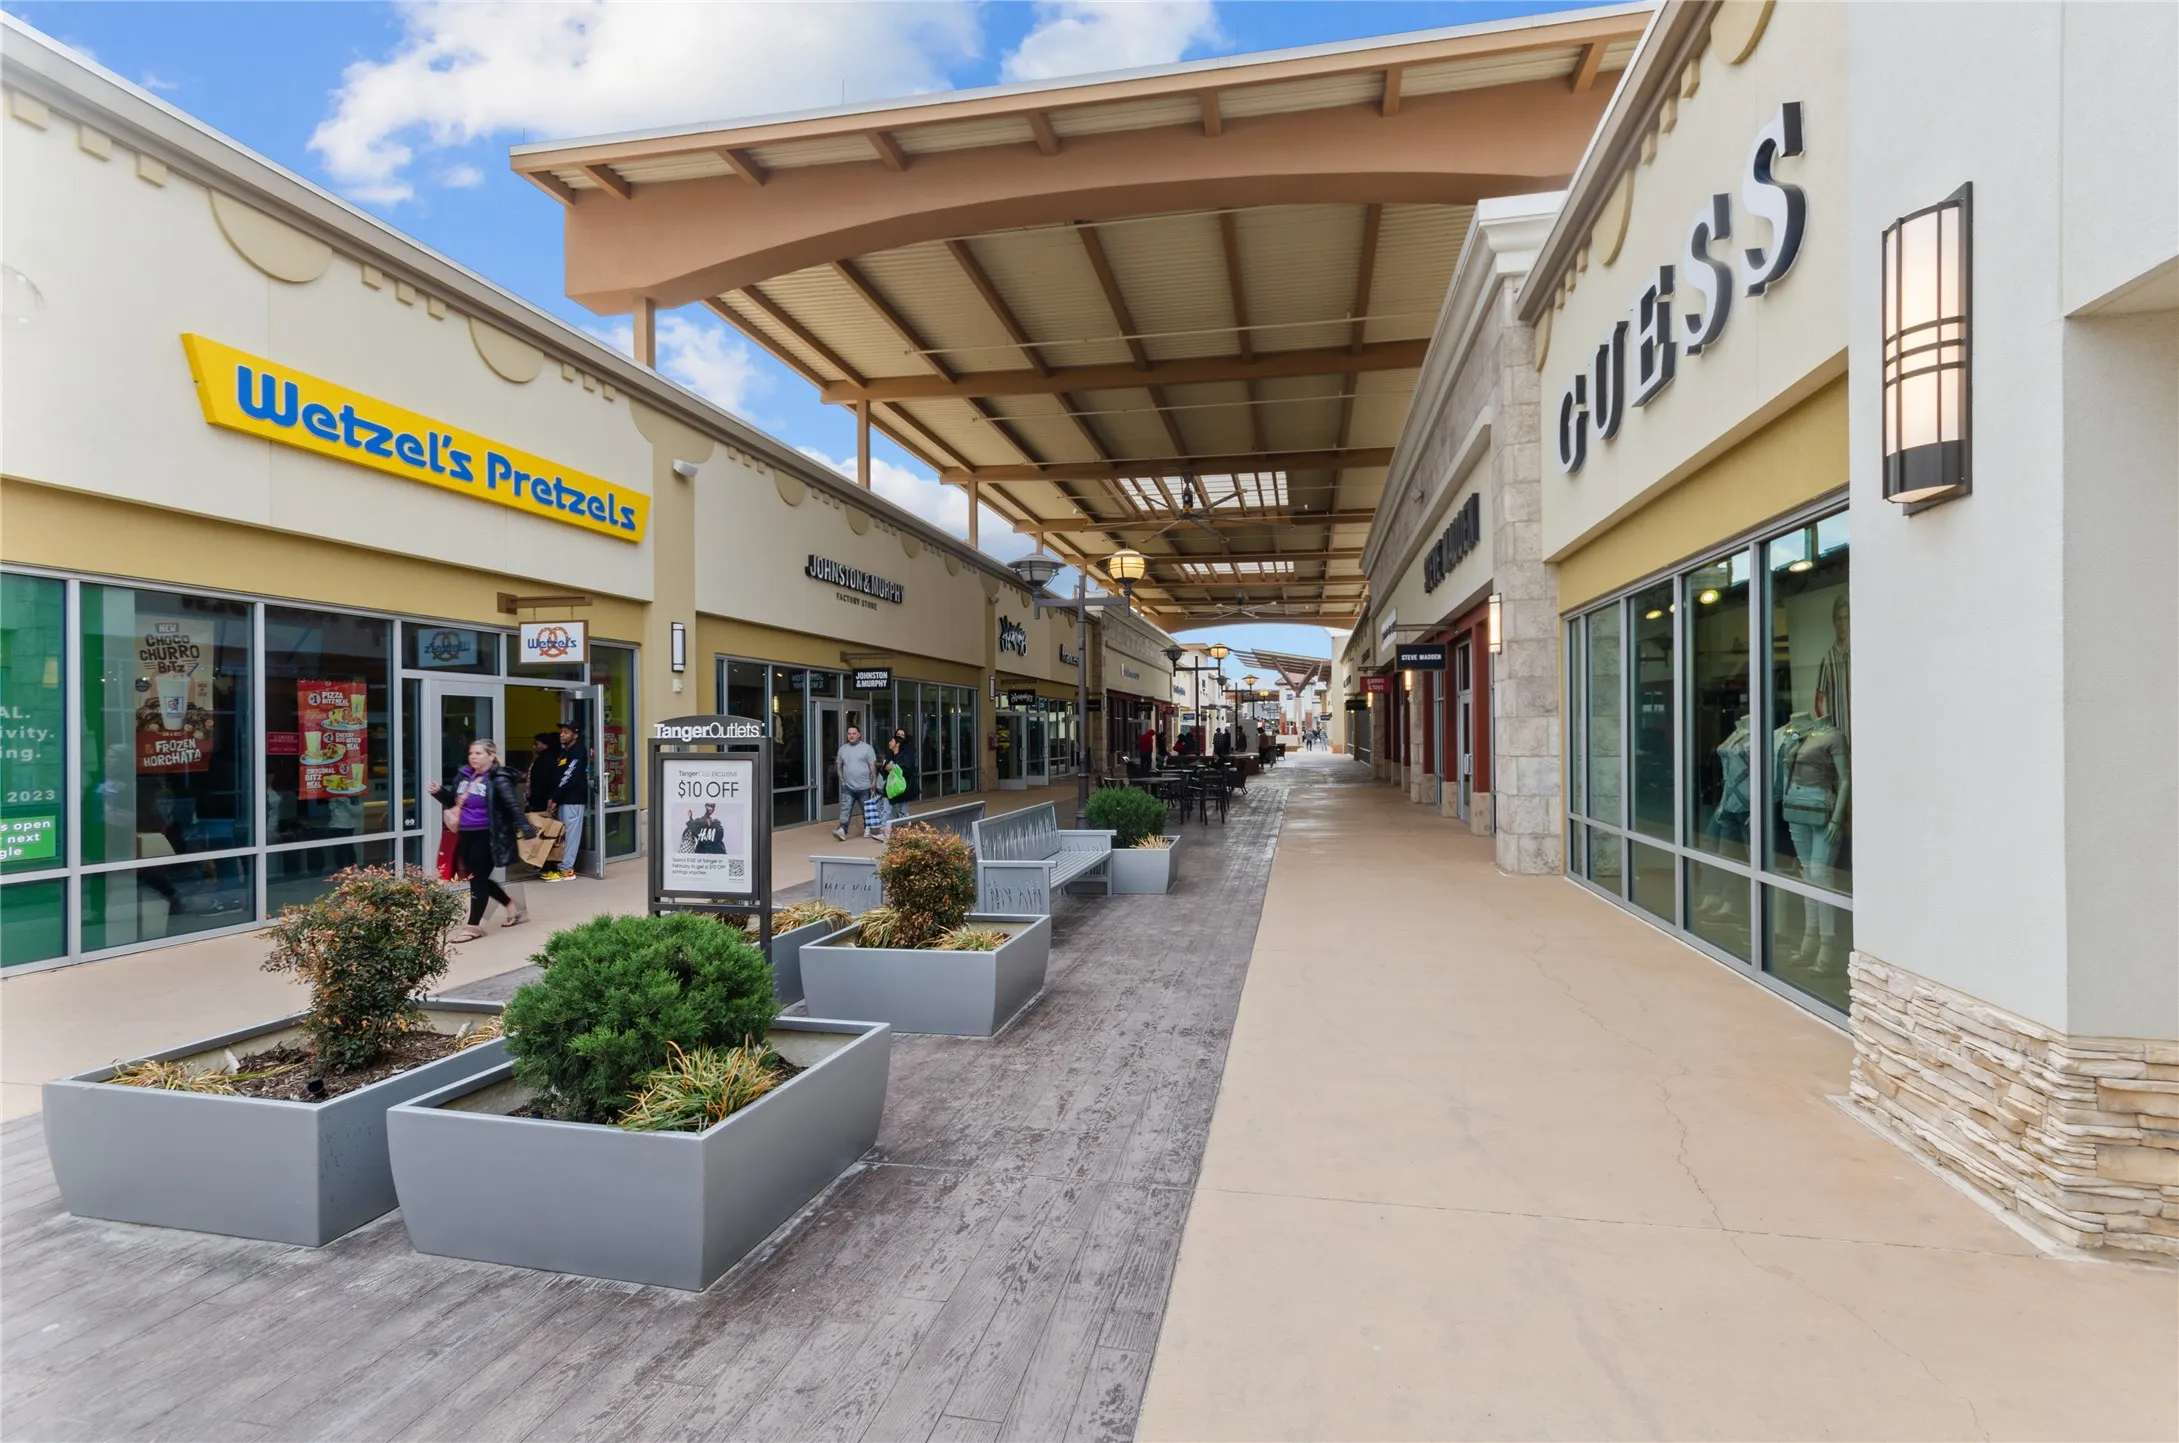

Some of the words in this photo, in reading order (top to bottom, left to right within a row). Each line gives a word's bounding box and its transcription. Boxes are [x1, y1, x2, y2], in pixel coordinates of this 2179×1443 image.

[1559, 101, 1807, 474] GUESS
[237, 364, 473, 482] Wetzel's
[487, 451, 637, 531] Pretzels
[145, 633, 190, 647] CHOCO
[527, 637, 577, 649] Wetzel's
[140, 645, 200, 661] CHURRO
[855, 671, 888, 680] JOHNSTON
[322, 691, 343, 699] PIZZA
[653, 722, 760, 742] TangerOutlets
[155, 738, 196, 753] FROZEN
[143, 749, 201, 767] HORCHATA
[7, 789, 56, 802] 2023
[678, 779, 702, 798] $10
[706, 781, 739, 798] OFF
[13, 819, 51, 833] open
[7, 832, 40, 843] next
